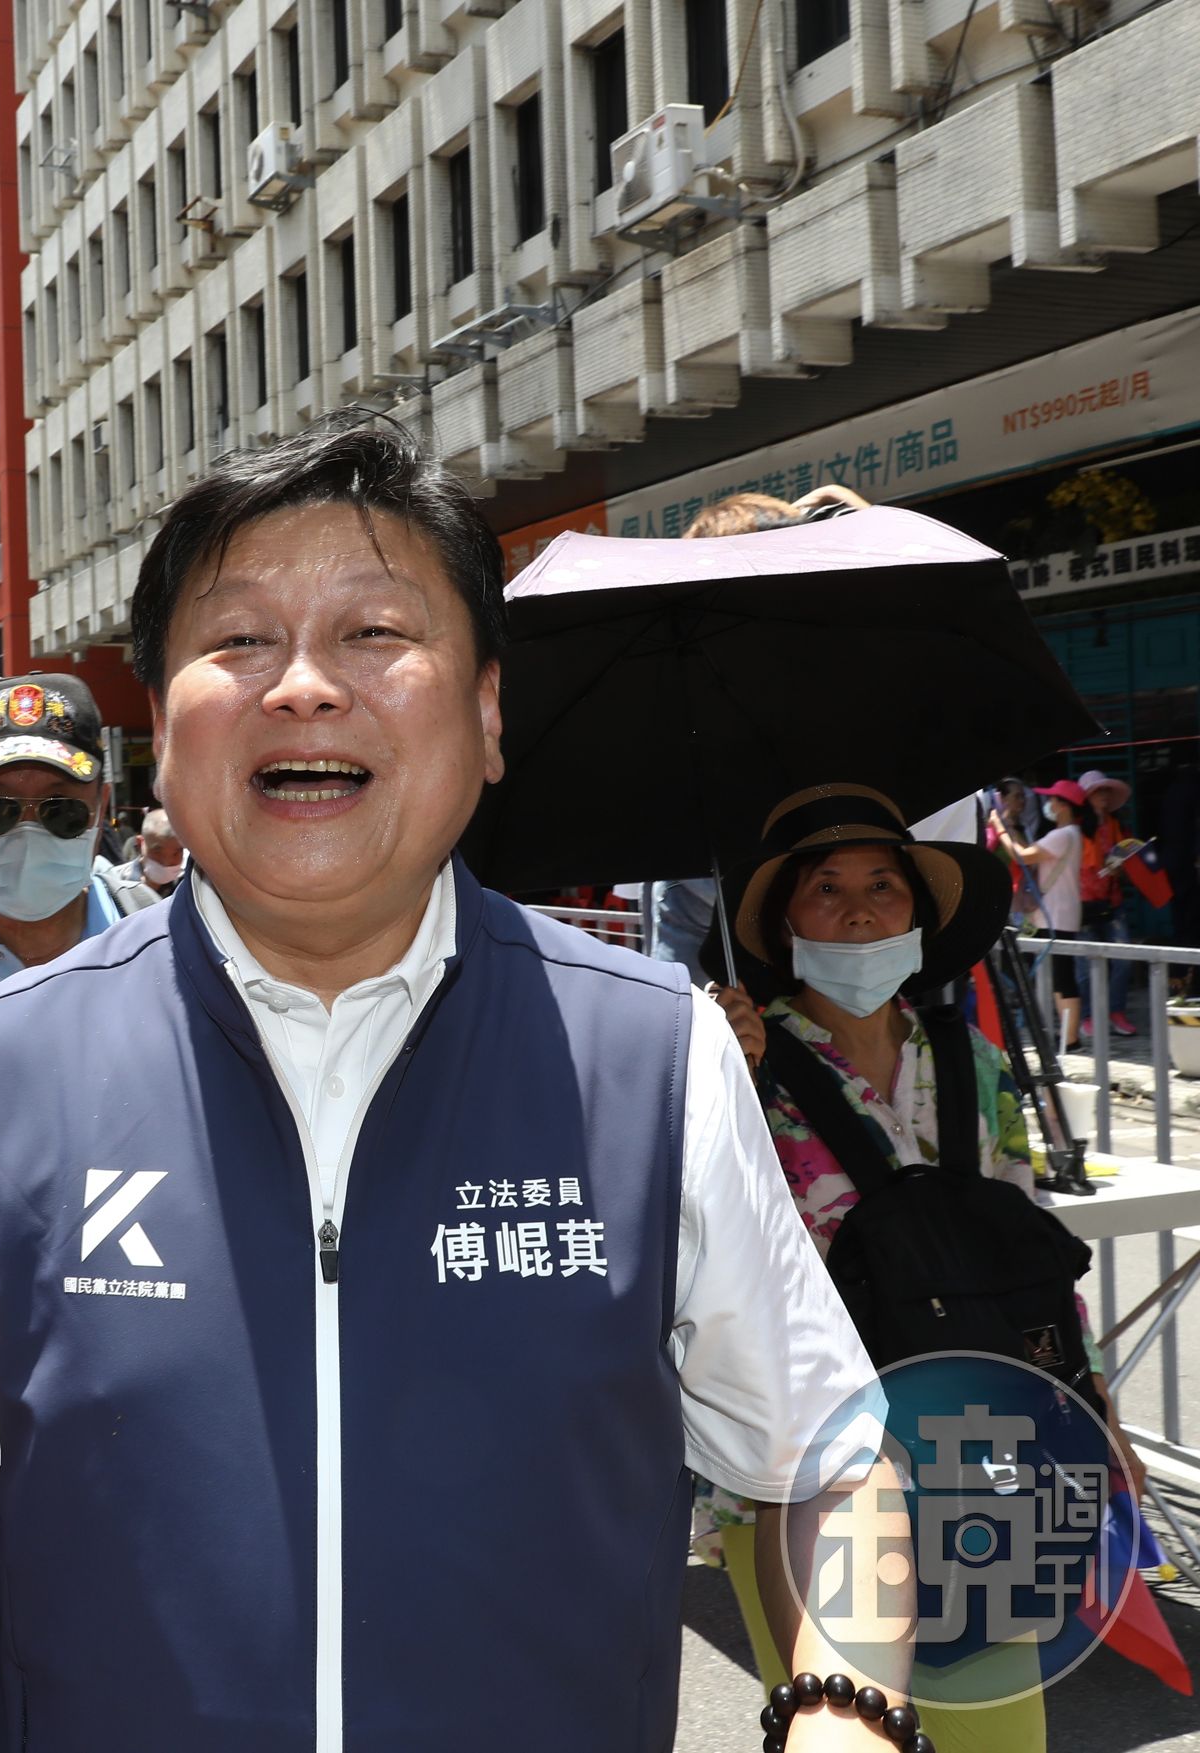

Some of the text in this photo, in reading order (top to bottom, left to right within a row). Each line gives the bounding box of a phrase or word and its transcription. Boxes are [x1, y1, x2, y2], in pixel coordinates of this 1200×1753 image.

[1003, 370, 1150, 435] NT$990元起/月
[455, 1177, 583, 1210] 立法委員
[430, 1219, 608, 1283] 傅崐萁
[63, 1276, 187, 1300] 國民黨立法院黨團
